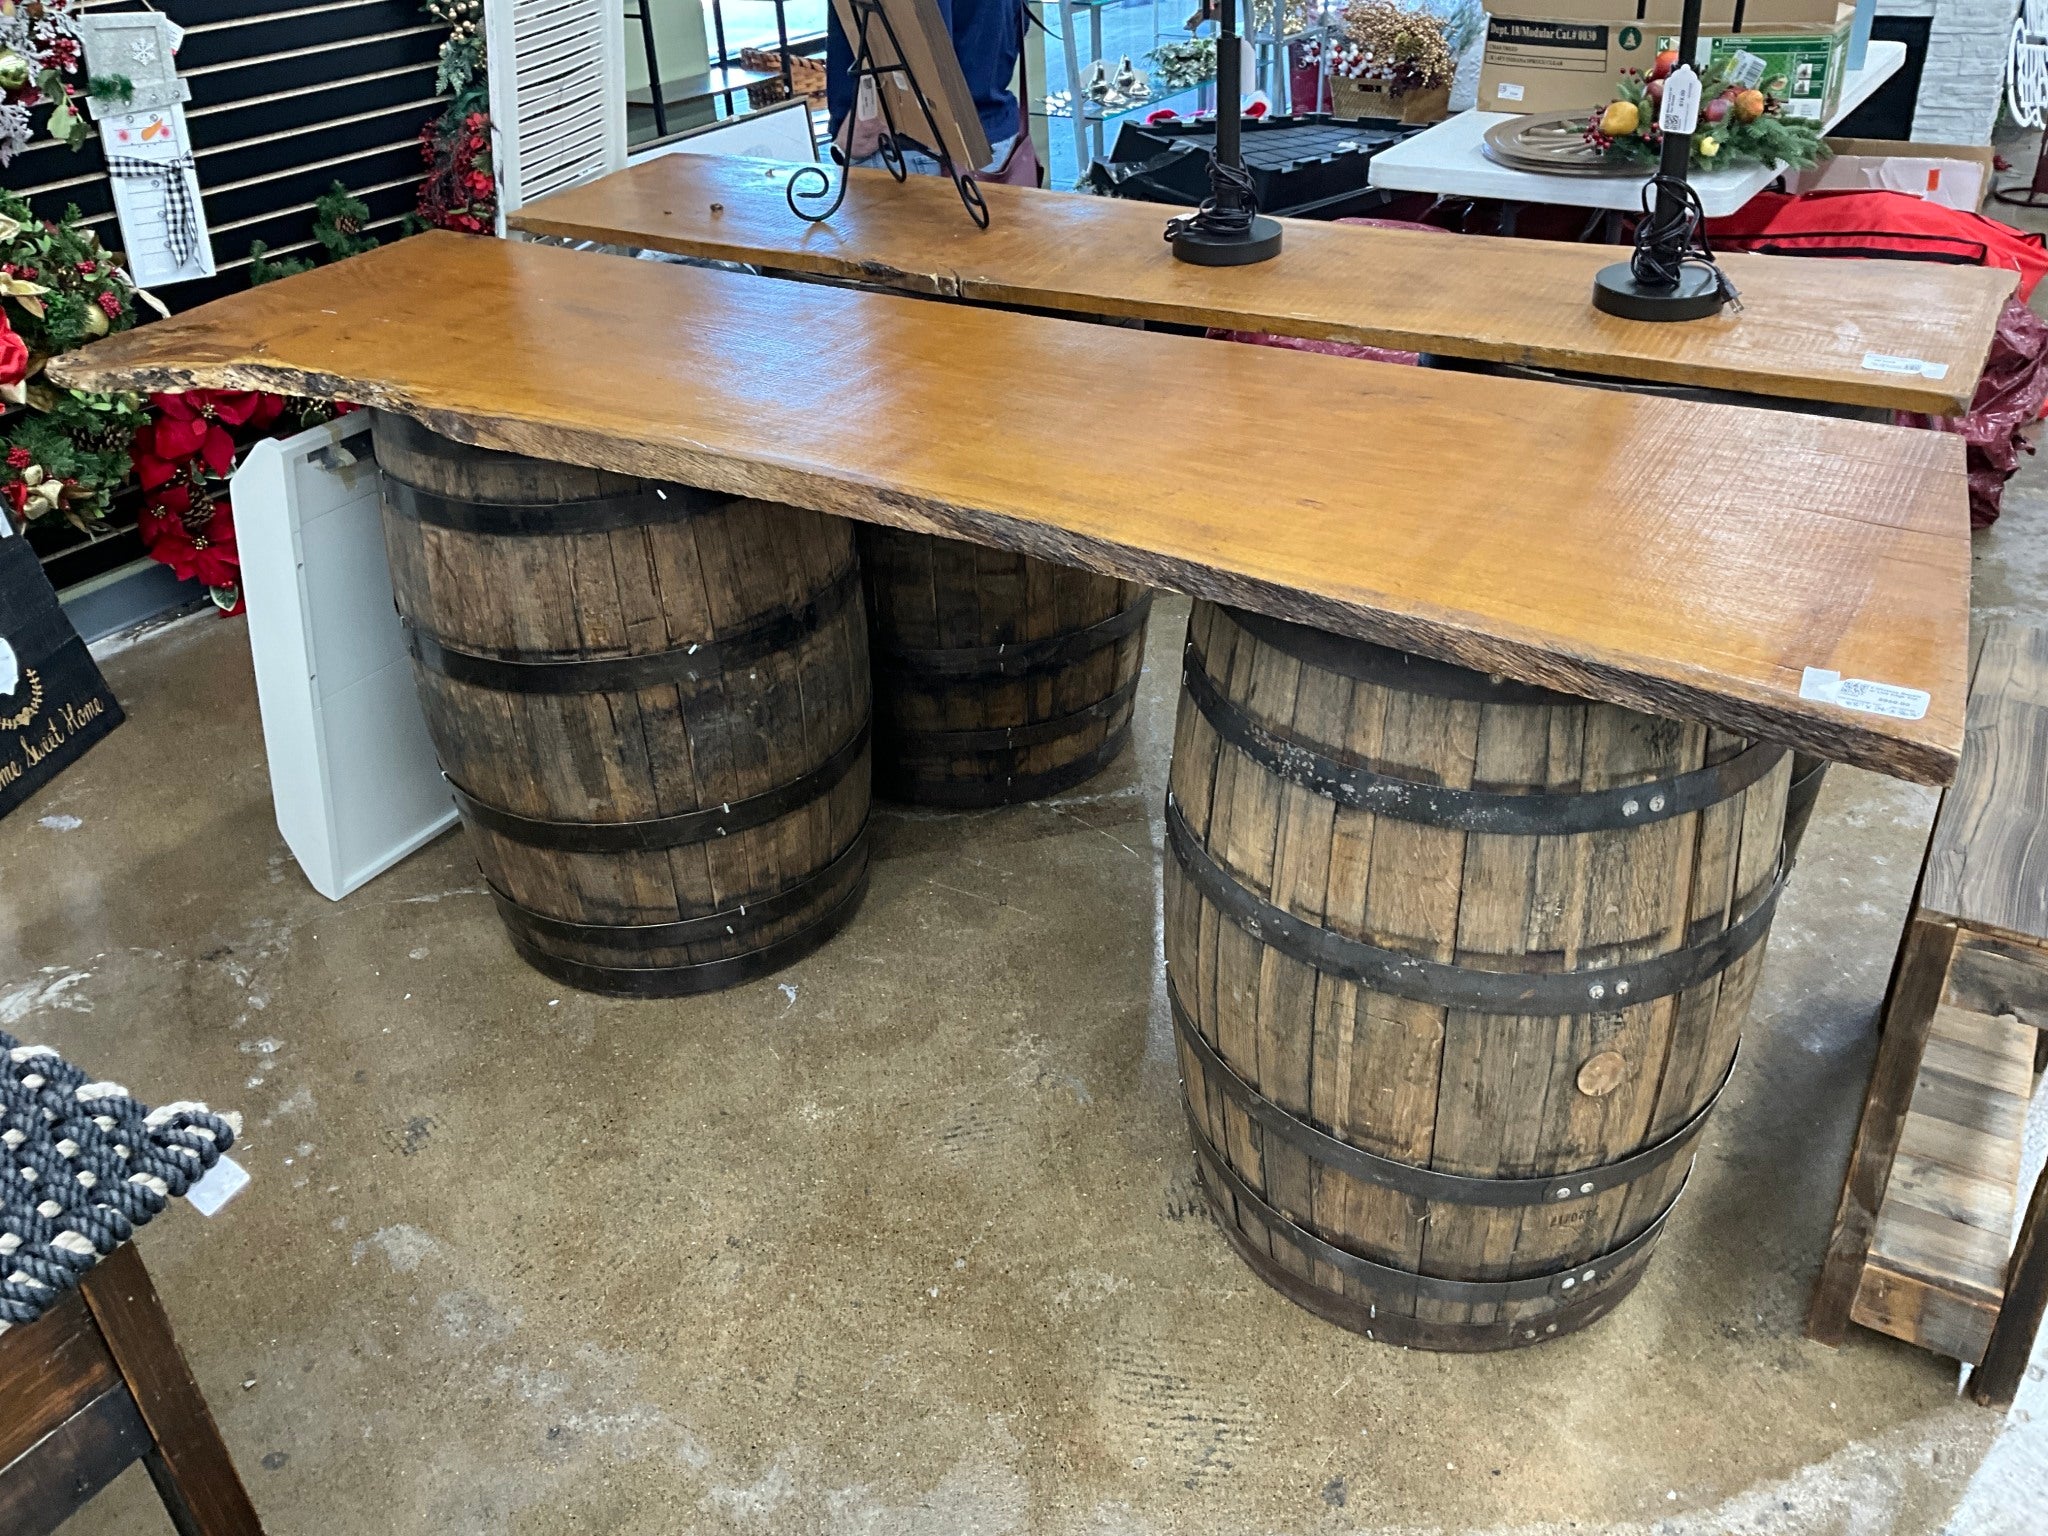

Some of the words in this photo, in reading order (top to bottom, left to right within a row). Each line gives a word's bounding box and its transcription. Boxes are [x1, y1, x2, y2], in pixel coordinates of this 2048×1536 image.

[1490, 22, 1509, 37] Dept.
[1660, 38, 1669, 50] K
[20, 717, 65, 769] Sweet
[58, 697, 105, 735] Home
